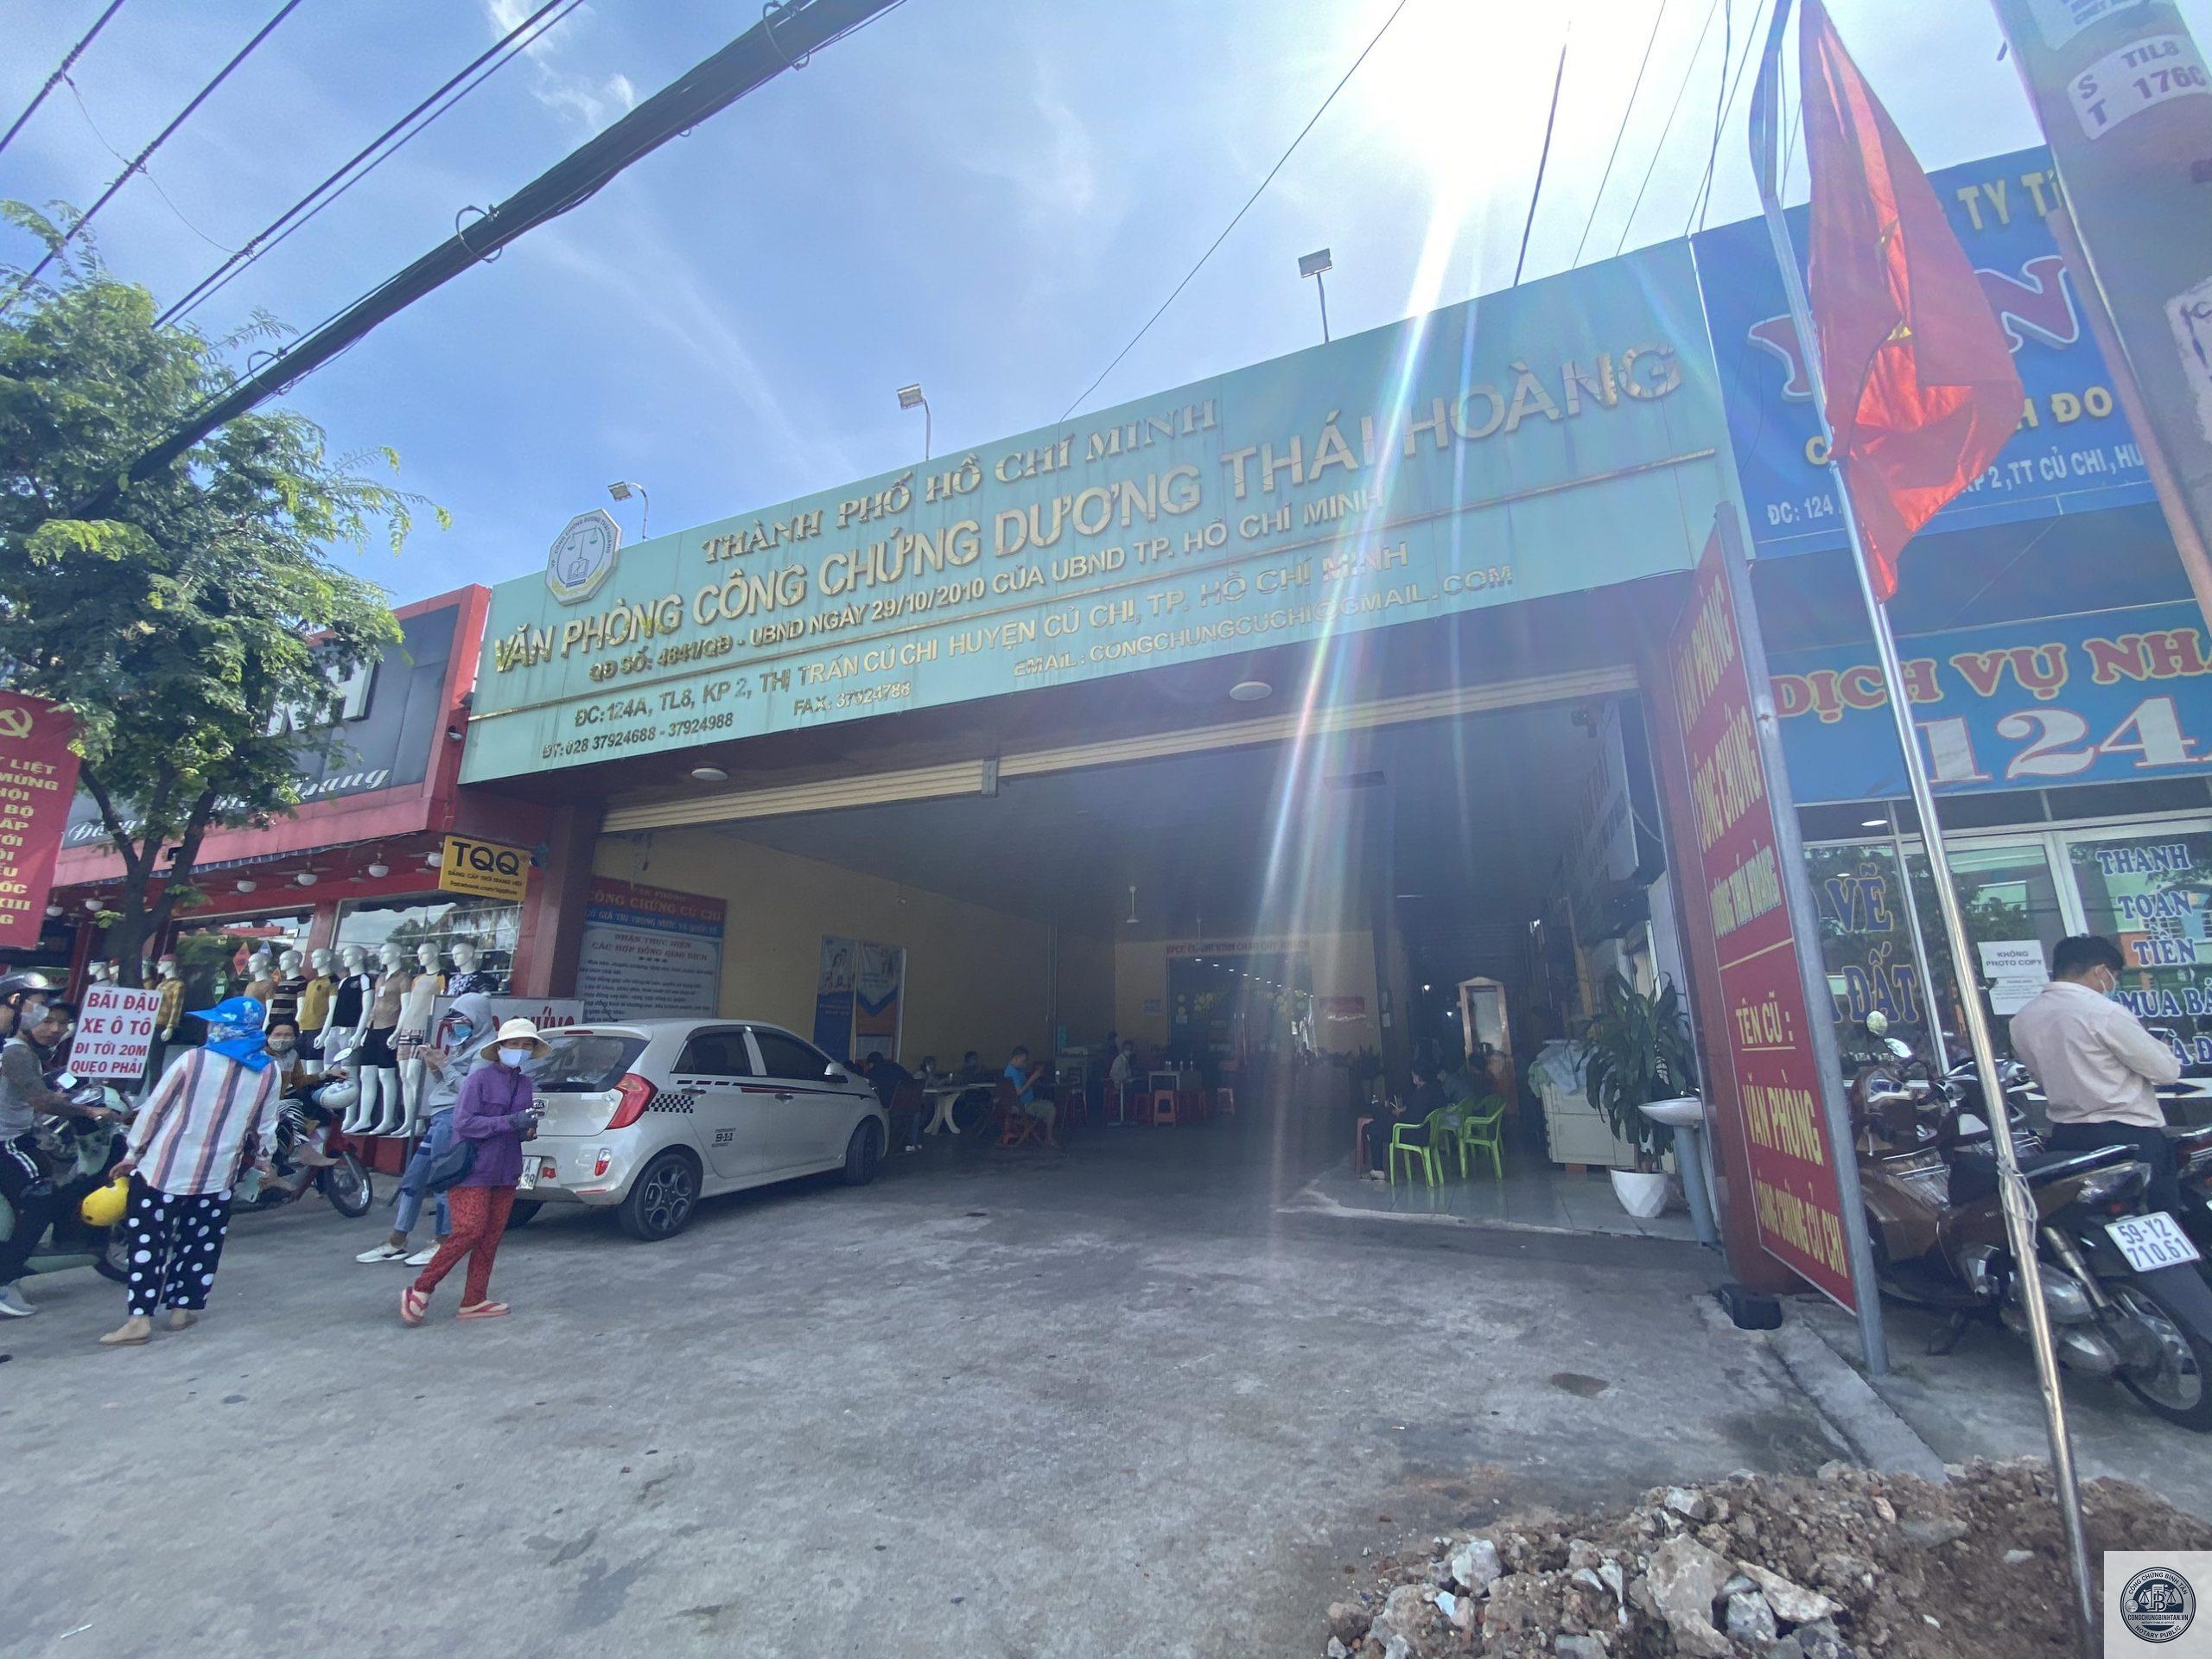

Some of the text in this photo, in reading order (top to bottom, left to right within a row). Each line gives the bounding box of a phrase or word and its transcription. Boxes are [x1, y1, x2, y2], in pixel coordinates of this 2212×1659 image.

[2077, 74, 2098, 99] S
[2086, 99, 2107, 126] T
[702, 398, 1217, 563] THÀNH PHỐ HỒ CHÍ MINH
[494, 341, 1682, 673] VĂN PHÒNG CÔNG CHỨNG DƯƠNG THÁI HOÀNG
[589, 659, 619, 682] QĐ
[620, 645, 653, 675] SỐ:
[750, 619, 805, 646] UBND
[809, 603, 868, 633] NGÀY
[871, 576, 986, 621] 29/10/2010
[993, 564, 1046, 595] CỦA
[1052, 547, 1126, 582] UBND
[1134, 538, 1175, 563] TP.
[1184, 518, 1228, 553] HỒ
[1238, 503, 1293, 539] CHÍ
[1303, 487, 1384, 526] MINH
[702, 682, 731, 704] KP
[760, 668, 791, 694] THỊ
[863, 645, 896, 673] CỦ
[900, 639, 938, 665] CHI
[949, 620, 1036, 658] HUYỆN
[1044, 606, 1080, 638] CỦ
[1089, 599, 1142, 629] CHI,
[1147, 589, 1189, 617] TP.
[1200, 570, 1247, 607] HỒ
[1256, 556, 1313, 594] CHÍ
[1322, 542, 1409, 582] MINH
[1769, 628, 2212, 724] DỊCH VỤ NH
[592, 728, 657, 751] 37924688
[668, 713, 734, 736] 37924988
[1915, 695, 2212, 785] 124
[451, 841, 519, 877] TQQ
[2095, 843, 2191, 876] THANH
[1825, 861, 1894, 932] VẼ
[2117, 884, 2192, 920] TOÁN
[1985, 959, 2016, 968] PHOTO
[1996, 950, 2030, 958] KHÔNG
[2131, 924, 2197, 968] TIỀN
[1841, 940, 1919, 1023] ĐẤT
[87, 989, 160, 1014] BÃI ĐẬU
[2120, 989, 2183, 1018] MUA
[81, 1015, 152, 1036] XE Ô TÔ
[1735, 997, 1763, 1045] TÊN
[74, 1040, 148, 1056] ĐI TỚI 20M
[71, 1058, 143, 1075] QUẸO PHẢI
[1741, 1068, 1824, 1166] VĂN PHÒNG
[1821, 1208, 1848, 1279] CHI
[2117, 1217, 2171, 1244] 59-Y2
[2127, 1237, 2192, 1268] 710.61
